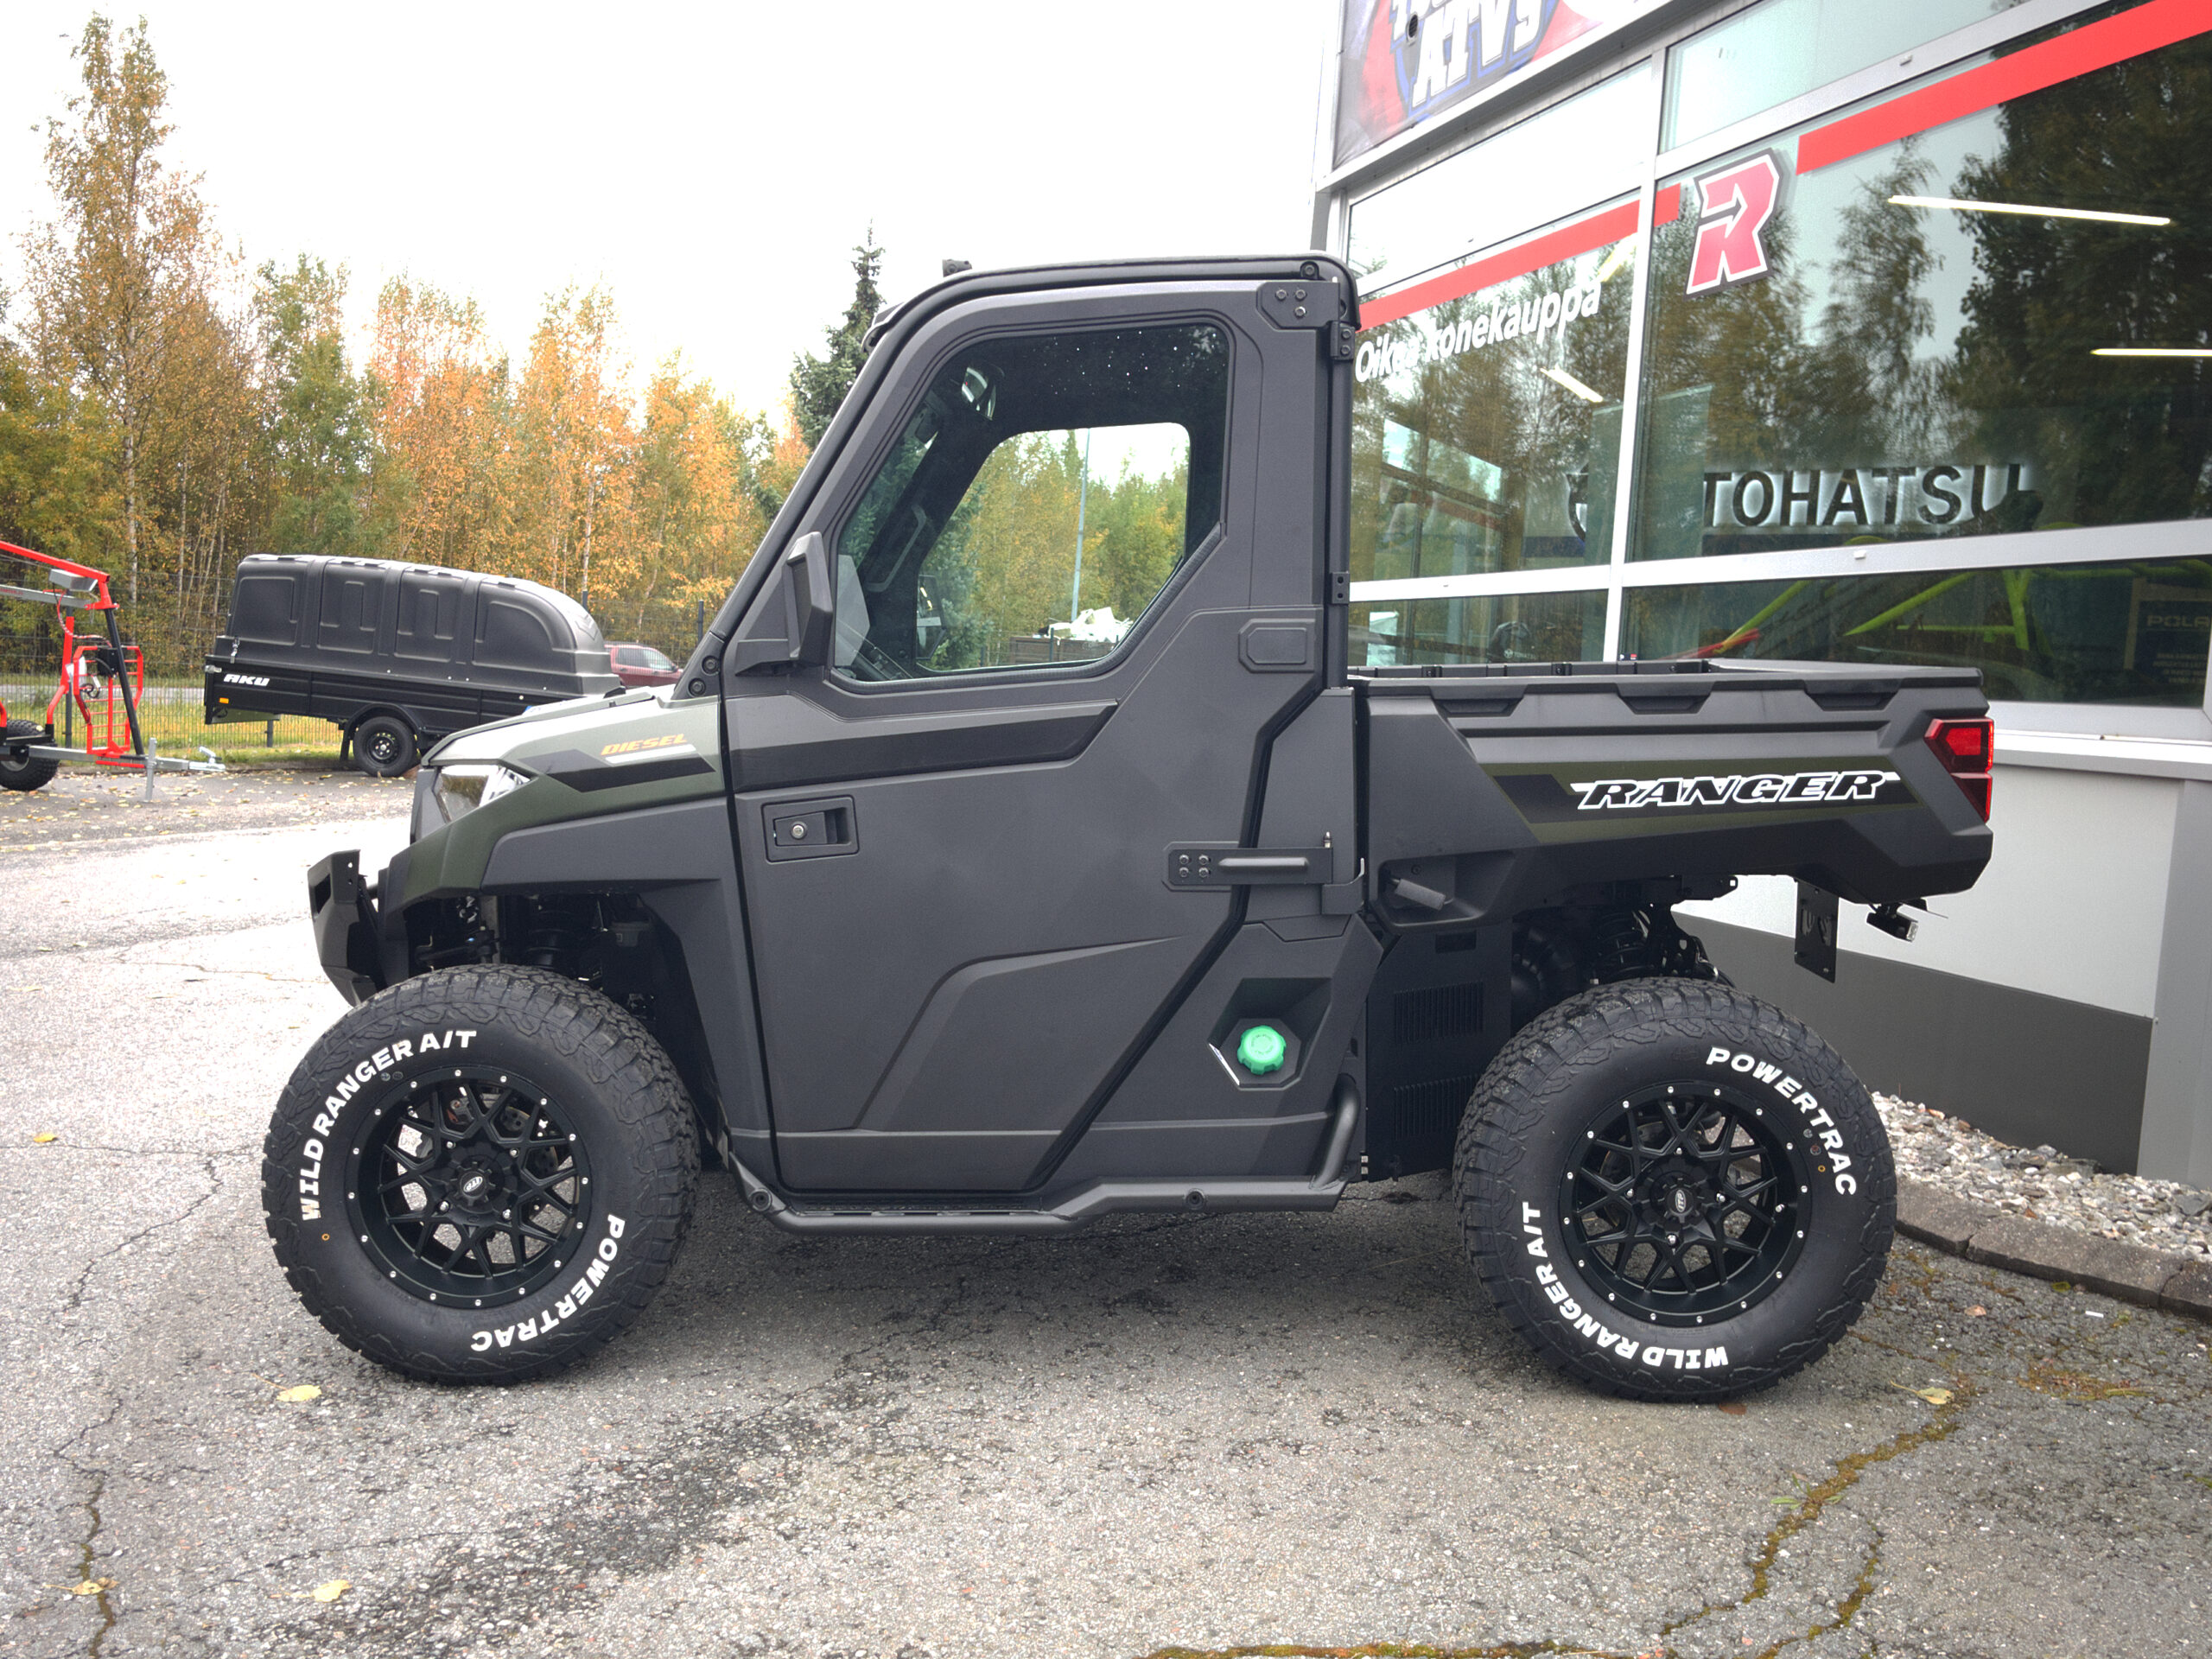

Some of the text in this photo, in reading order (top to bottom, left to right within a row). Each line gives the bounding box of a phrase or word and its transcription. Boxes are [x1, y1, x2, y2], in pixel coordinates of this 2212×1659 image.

[1426, 282, 1602, 361] konekauppa
[1702, 463, 2024, 527] TOHATSU
[224, 674, 270, 687] AKU
[601, 733, 688, 756] DIESEL
[1571, 771, 1900, 810] RANGER
[299, 1030, 477, 1221] WILD RANGER A/T
[1706, 1046, 1857, 1196] POWERTRAC
[470, 1214, 626, 1352] POWERTRAC
[1522, 1201, 1729, 1370] WILD RANGER A/T
